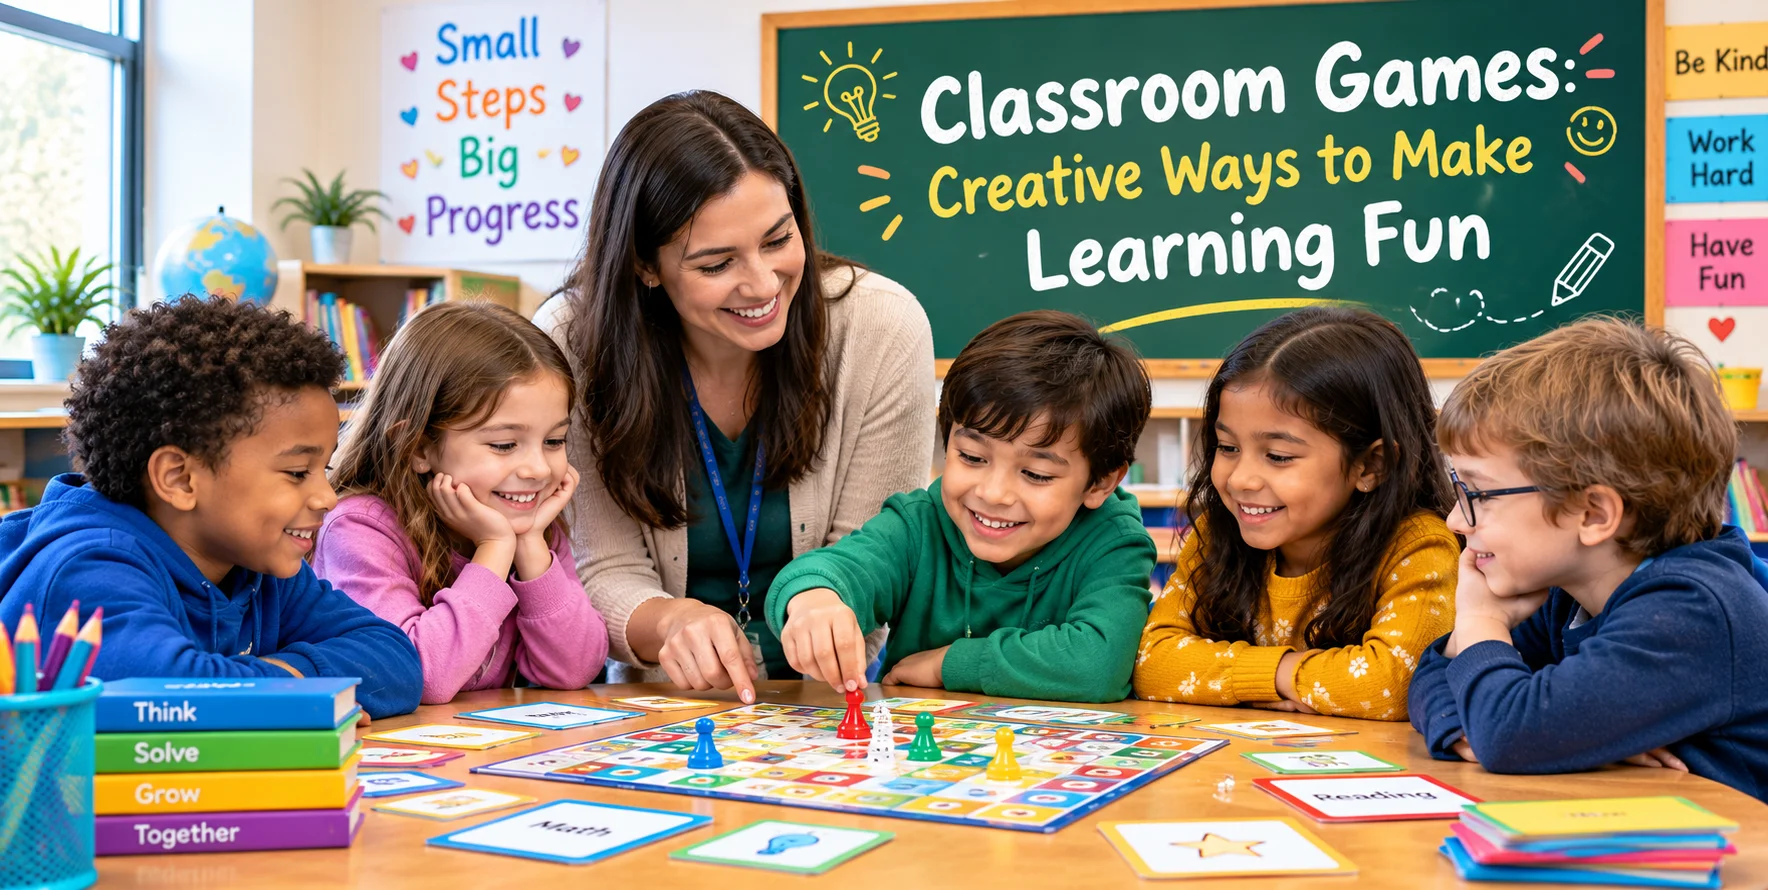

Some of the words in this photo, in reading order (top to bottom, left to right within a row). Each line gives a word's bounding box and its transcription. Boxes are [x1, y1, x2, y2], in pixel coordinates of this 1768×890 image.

[437, 16, 540, 65] Small
[1675, 50, 1705, 75] Be
[1715, 46, 1768, 73] Kind
[437, 80, 545, 129] Steps
[921, 66, 1285, 144] Classroom
[1316, 41, 1575, 112] Games:
[1688, 128, 1755, 154] Work
[460, 136, 518, 189] Big
[929, 155, 1142, 218] Creative
[1161, 142, 1299, 205] Ways
[1317, 135, 1371, 184] to
[1393, 124, 1533, 180] Make
[1691, 161, 1754, 187] Hard
[428, 196, 578, 245] Progress
[1027, 212, 1334, 291] Learning
[1364, 201, 1489, 266] Fun
[1691, 233, 1754, 257] Have
[1700, 266, 1745, 290] Fun
[134, 702, 195, 721] Think
[135, 742, 199, 763] Solve
[135, 783, 200, 804] Grow
[1313, 791, 1437, 801] Reading
[135, 822, 239, 848] Together
[530, 820, 613, 837] Math
